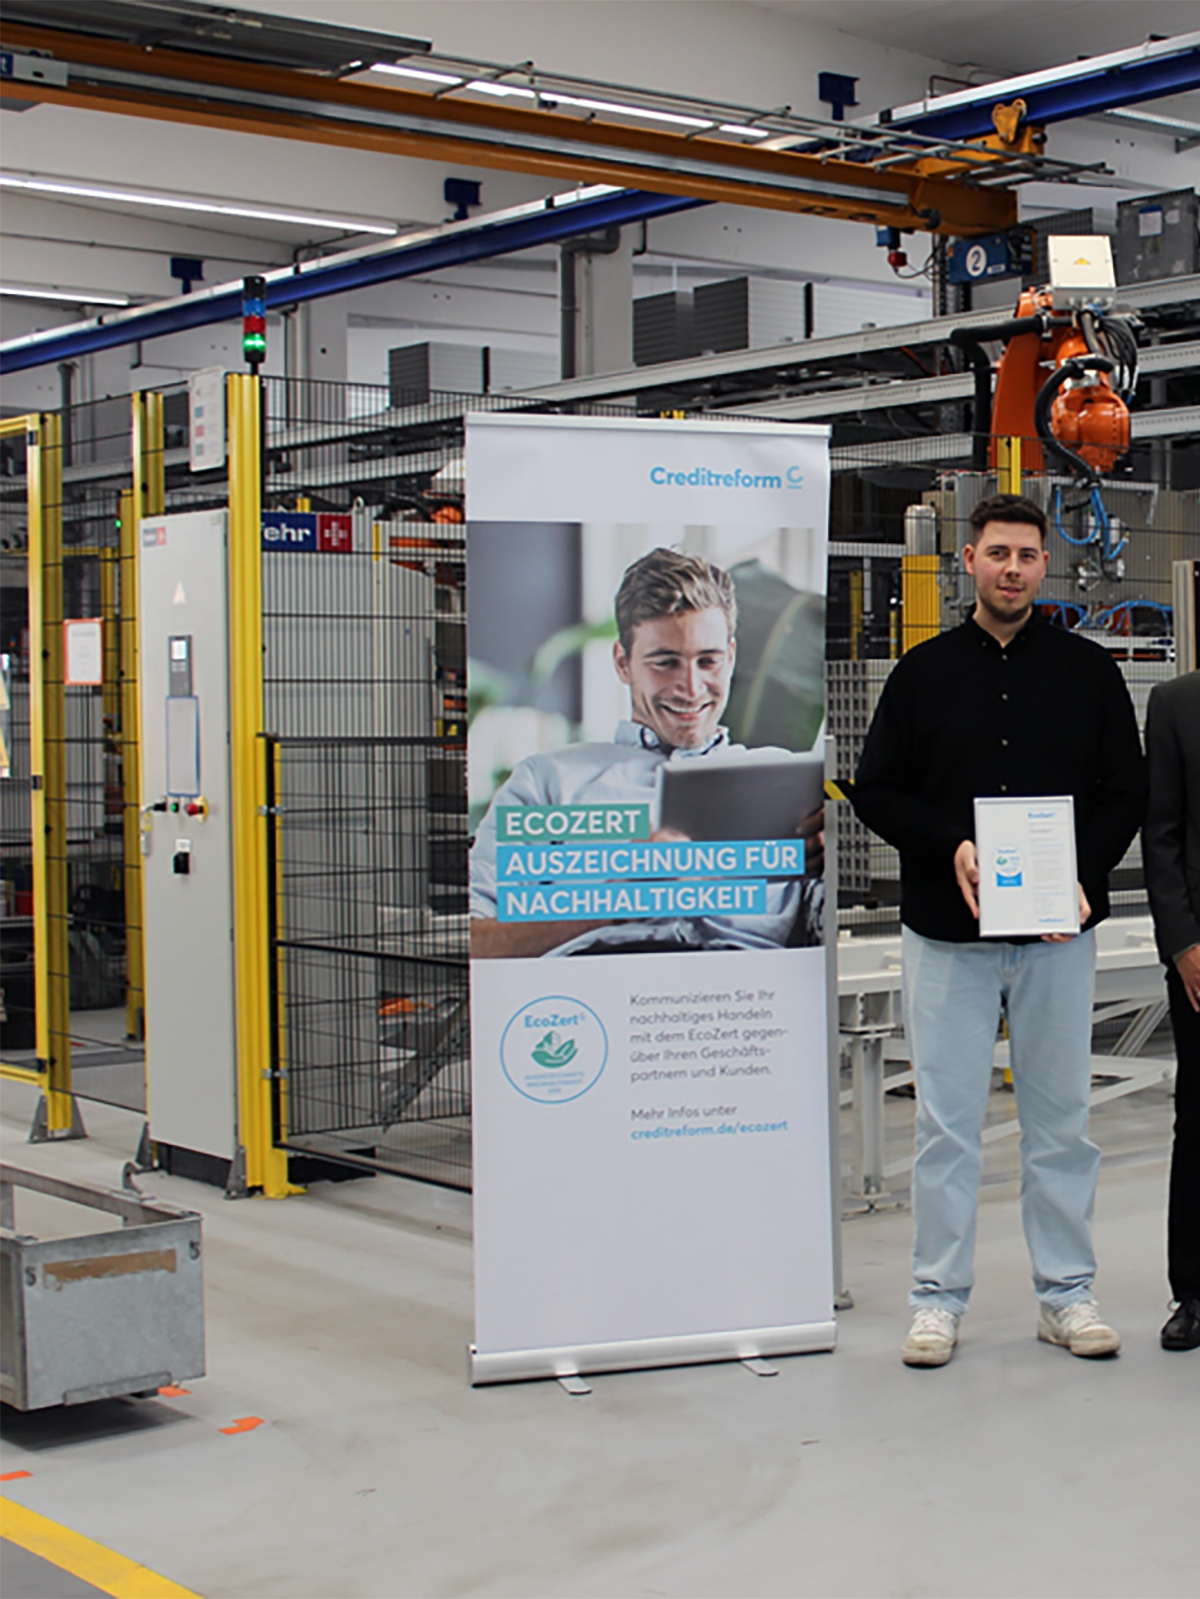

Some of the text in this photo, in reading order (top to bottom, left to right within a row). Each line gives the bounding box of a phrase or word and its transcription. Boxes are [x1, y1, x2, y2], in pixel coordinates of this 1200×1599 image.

[971, 250, 981, 271] 2
[650, 466, 782, 490] Creditreform
[261, 521, 311, 542] ehr
[505, 810, 641, 836] ECOZERT
[505, 841, 798, 876] AUSZEICHNUNG FÜR
[506, 885, 759, 915] NACHHALTIGKEIT
[629, 989, 776, 1007] Kommunizieren Sie Ihr
[524, 1013, 579, 1029] EcoZert
[629, 1008, 773, 1027] nachhaltiges Handeln
[629, 1027, 788, 1044] mit dem EcoZert gegen-
[629, 1045, 771, 1063] über Ihren Geschäfts-
[630, 1064, 772, 1084] partnern und Kunden.
[631, 1105, 738, 1121] Mehr Infos unter
[630, 1120, 788, 1141] creditreform.de/ecozert
